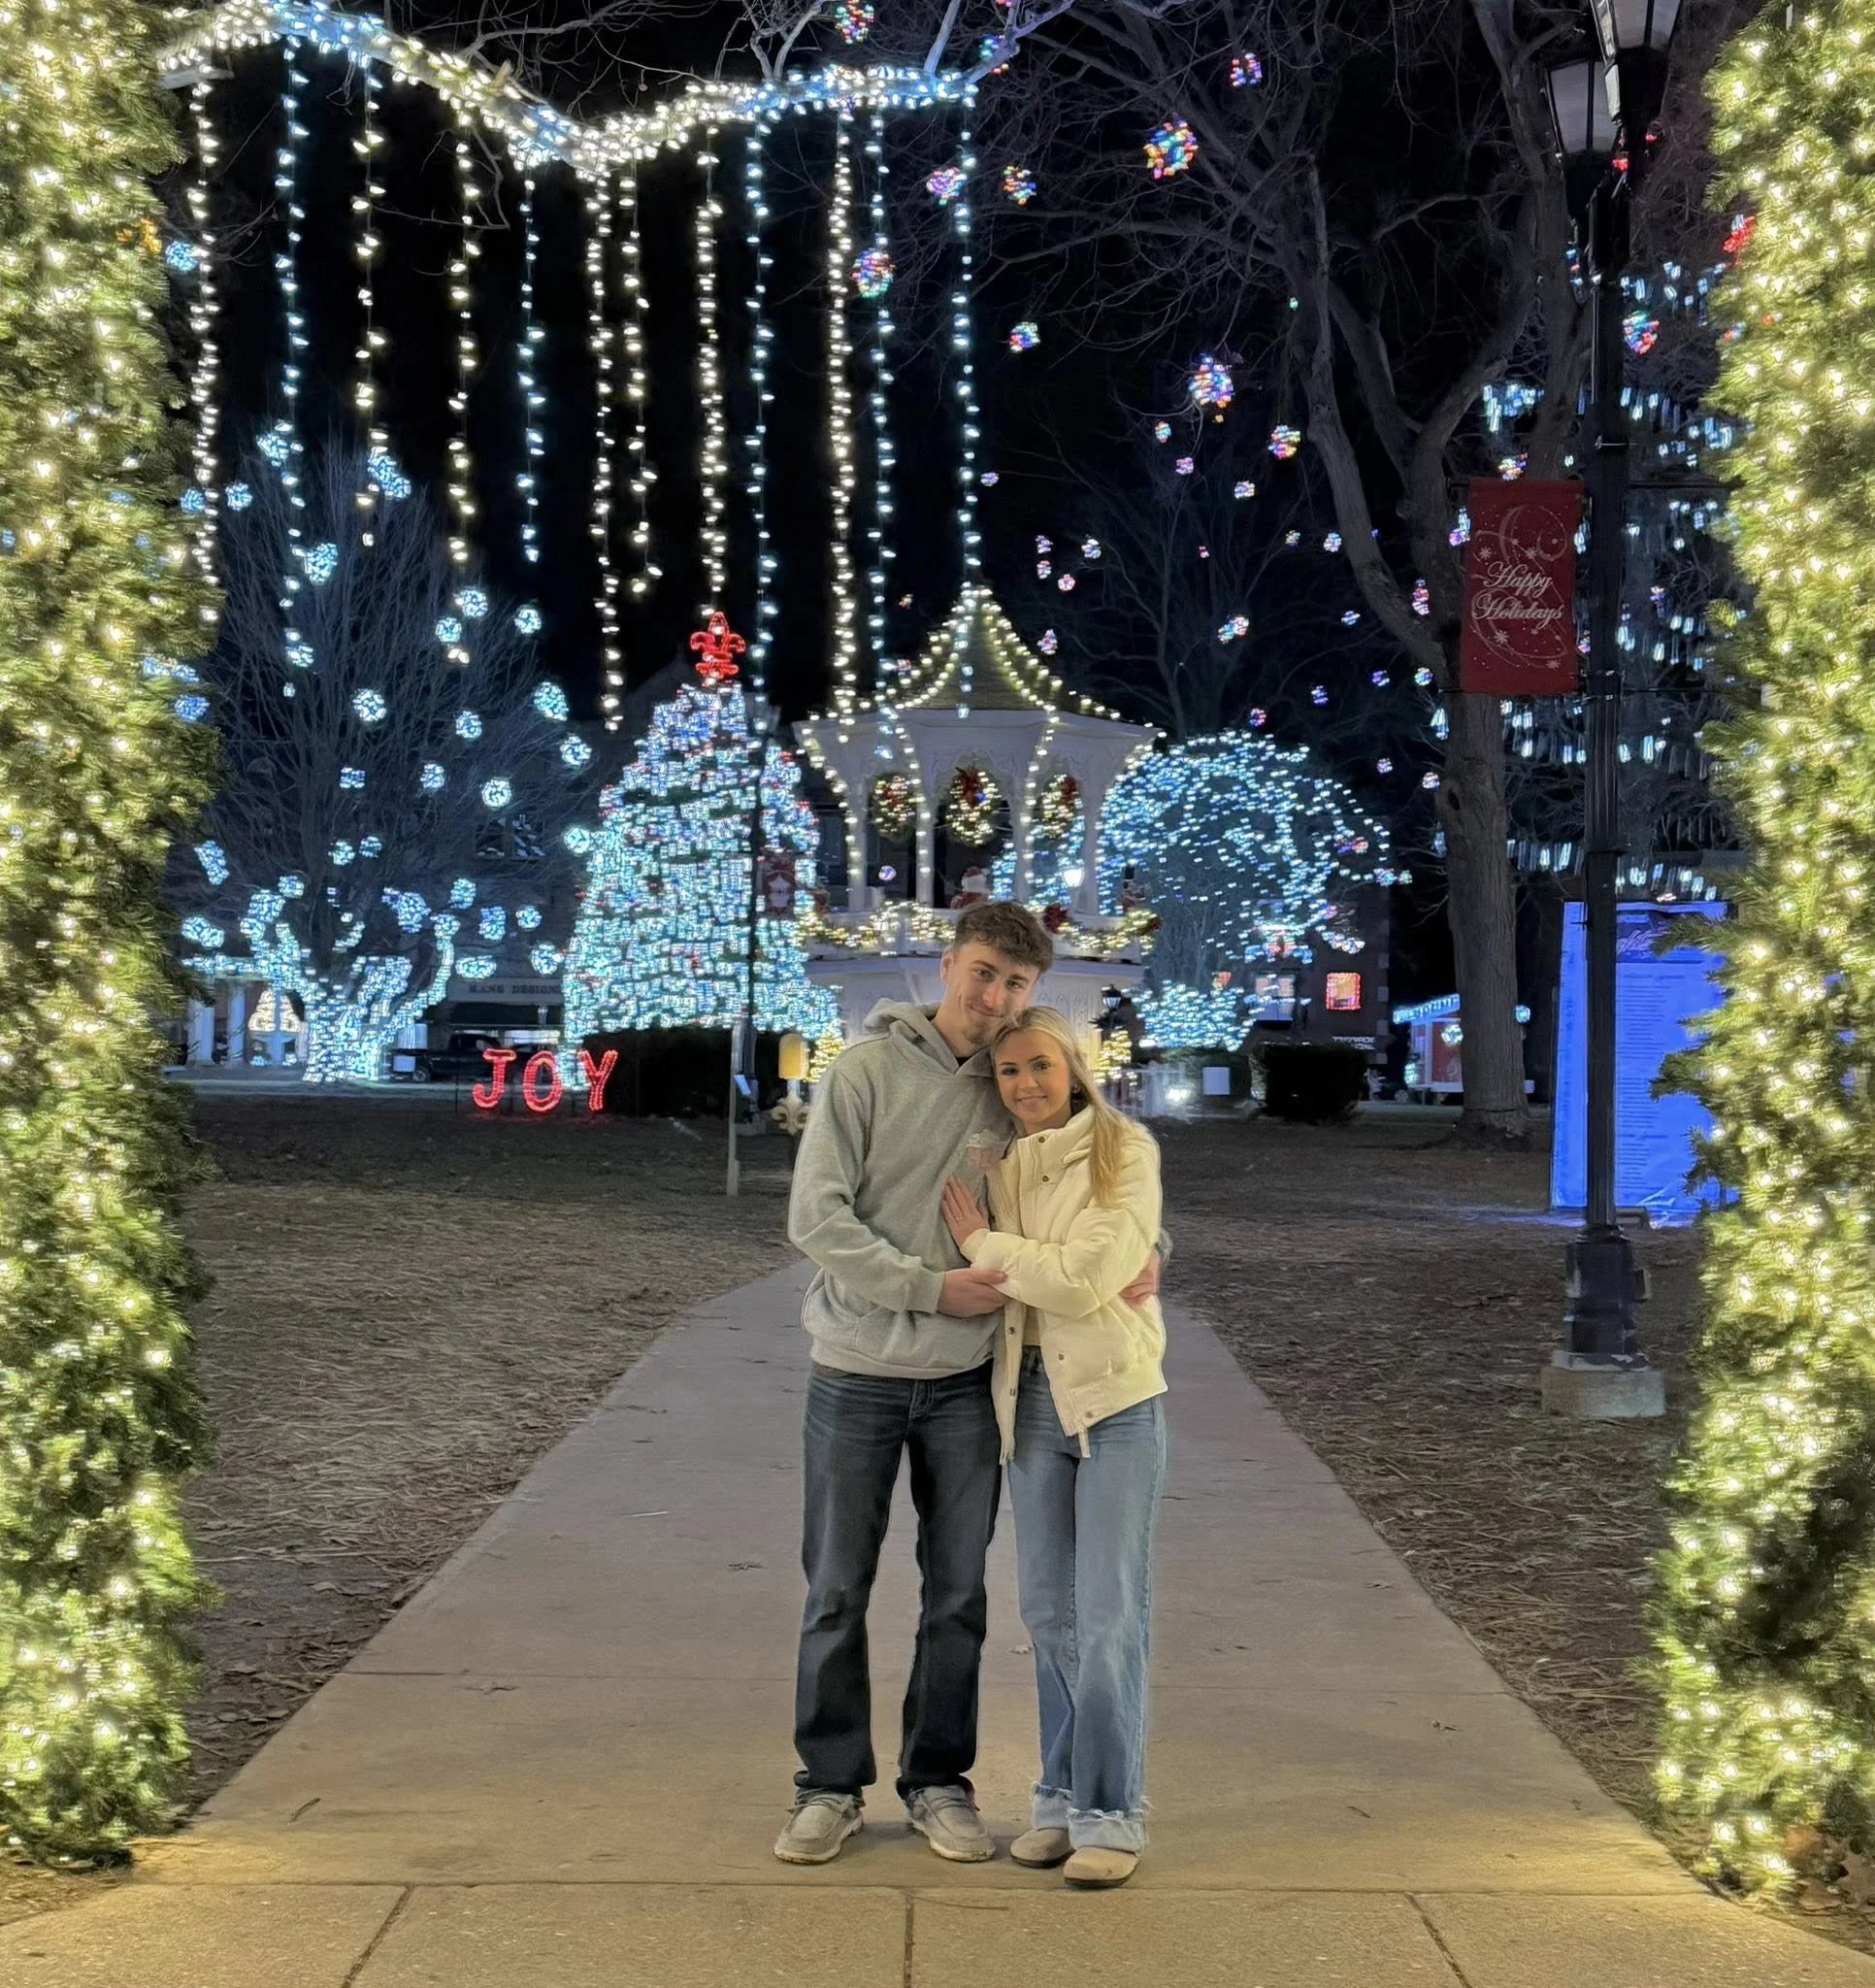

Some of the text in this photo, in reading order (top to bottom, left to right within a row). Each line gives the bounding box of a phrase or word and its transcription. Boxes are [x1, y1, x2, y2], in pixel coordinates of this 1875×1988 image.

[1484, 561, 1552, 597] Happy
[1474, 593, 1563, 629] Holidays
[472, 1048, 618, 1111] JOY
